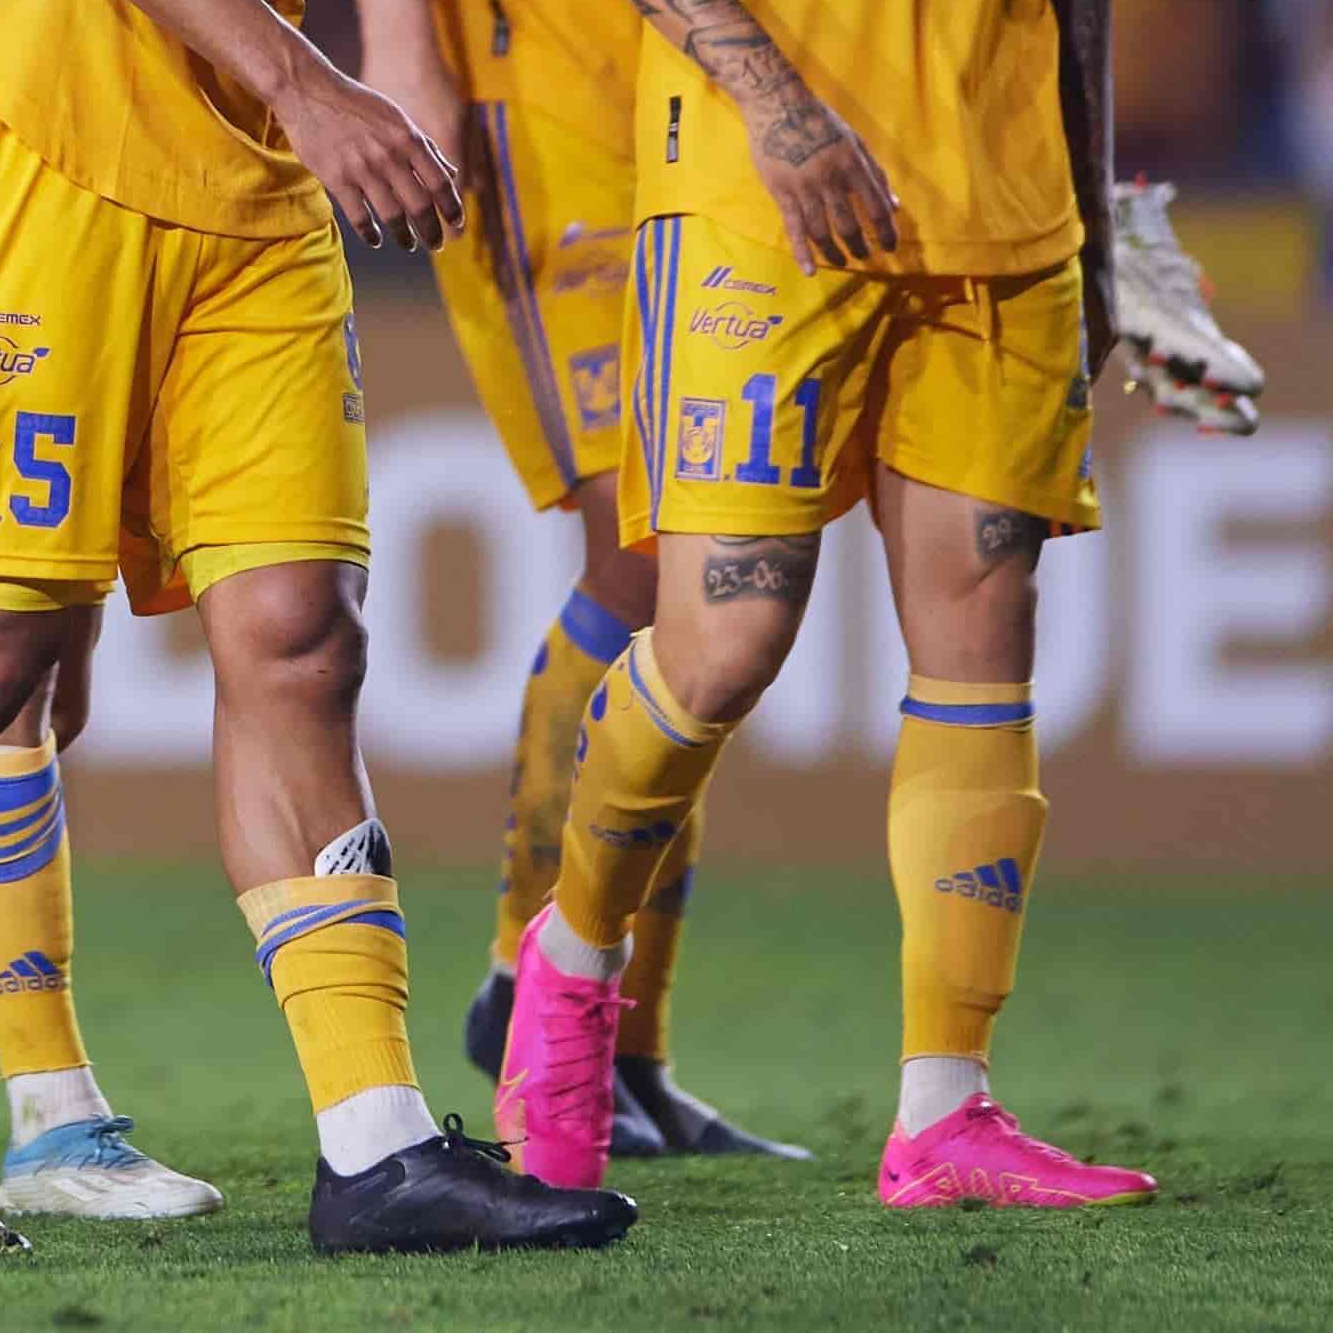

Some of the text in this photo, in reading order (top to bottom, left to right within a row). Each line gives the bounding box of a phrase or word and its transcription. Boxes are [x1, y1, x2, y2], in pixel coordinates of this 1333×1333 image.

[690, 307, 770, 339] Vertua
[9, 411, 76, 528] 5
[735, 373, 822, 489] 11
